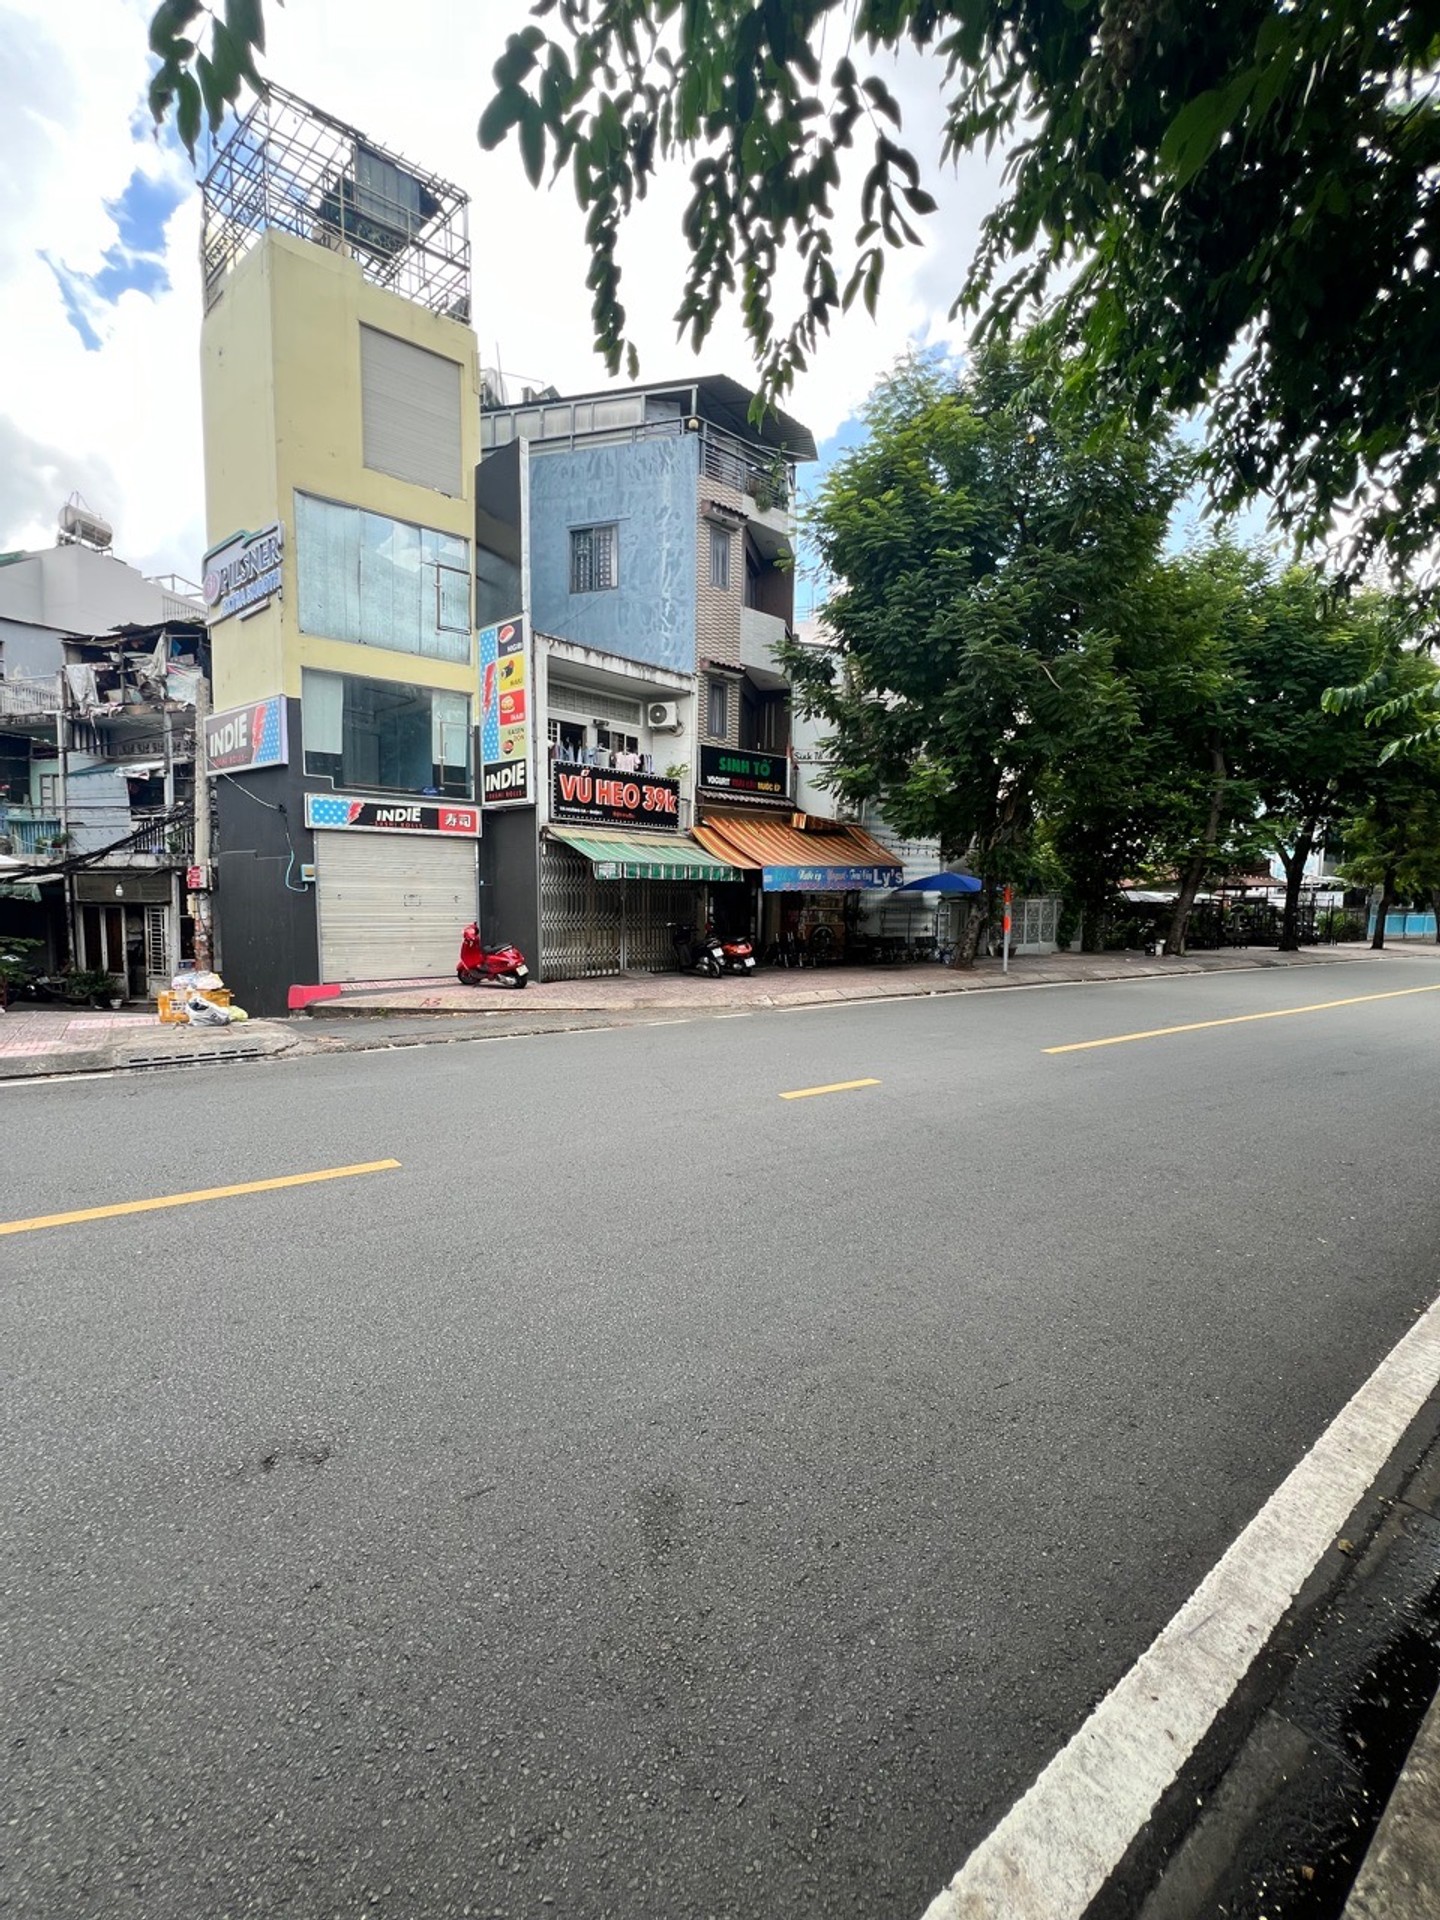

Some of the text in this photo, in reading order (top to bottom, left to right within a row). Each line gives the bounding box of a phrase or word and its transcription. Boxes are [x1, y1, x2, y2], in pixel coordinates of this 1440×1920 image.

[220, 537, 282, 595] PILSNER
[210, 712, 247, 758] INDIE
[485, 761, 525, 792] INDIE
[718, 757, 773, 777] SINH TỐ
[559, 768, 678, 813] VÚ HEO 39k
[376, 807, 422, 822] INDIE
[444, 813, 472, 827] 寿司
[873, 868, 903, 888] Ly's
